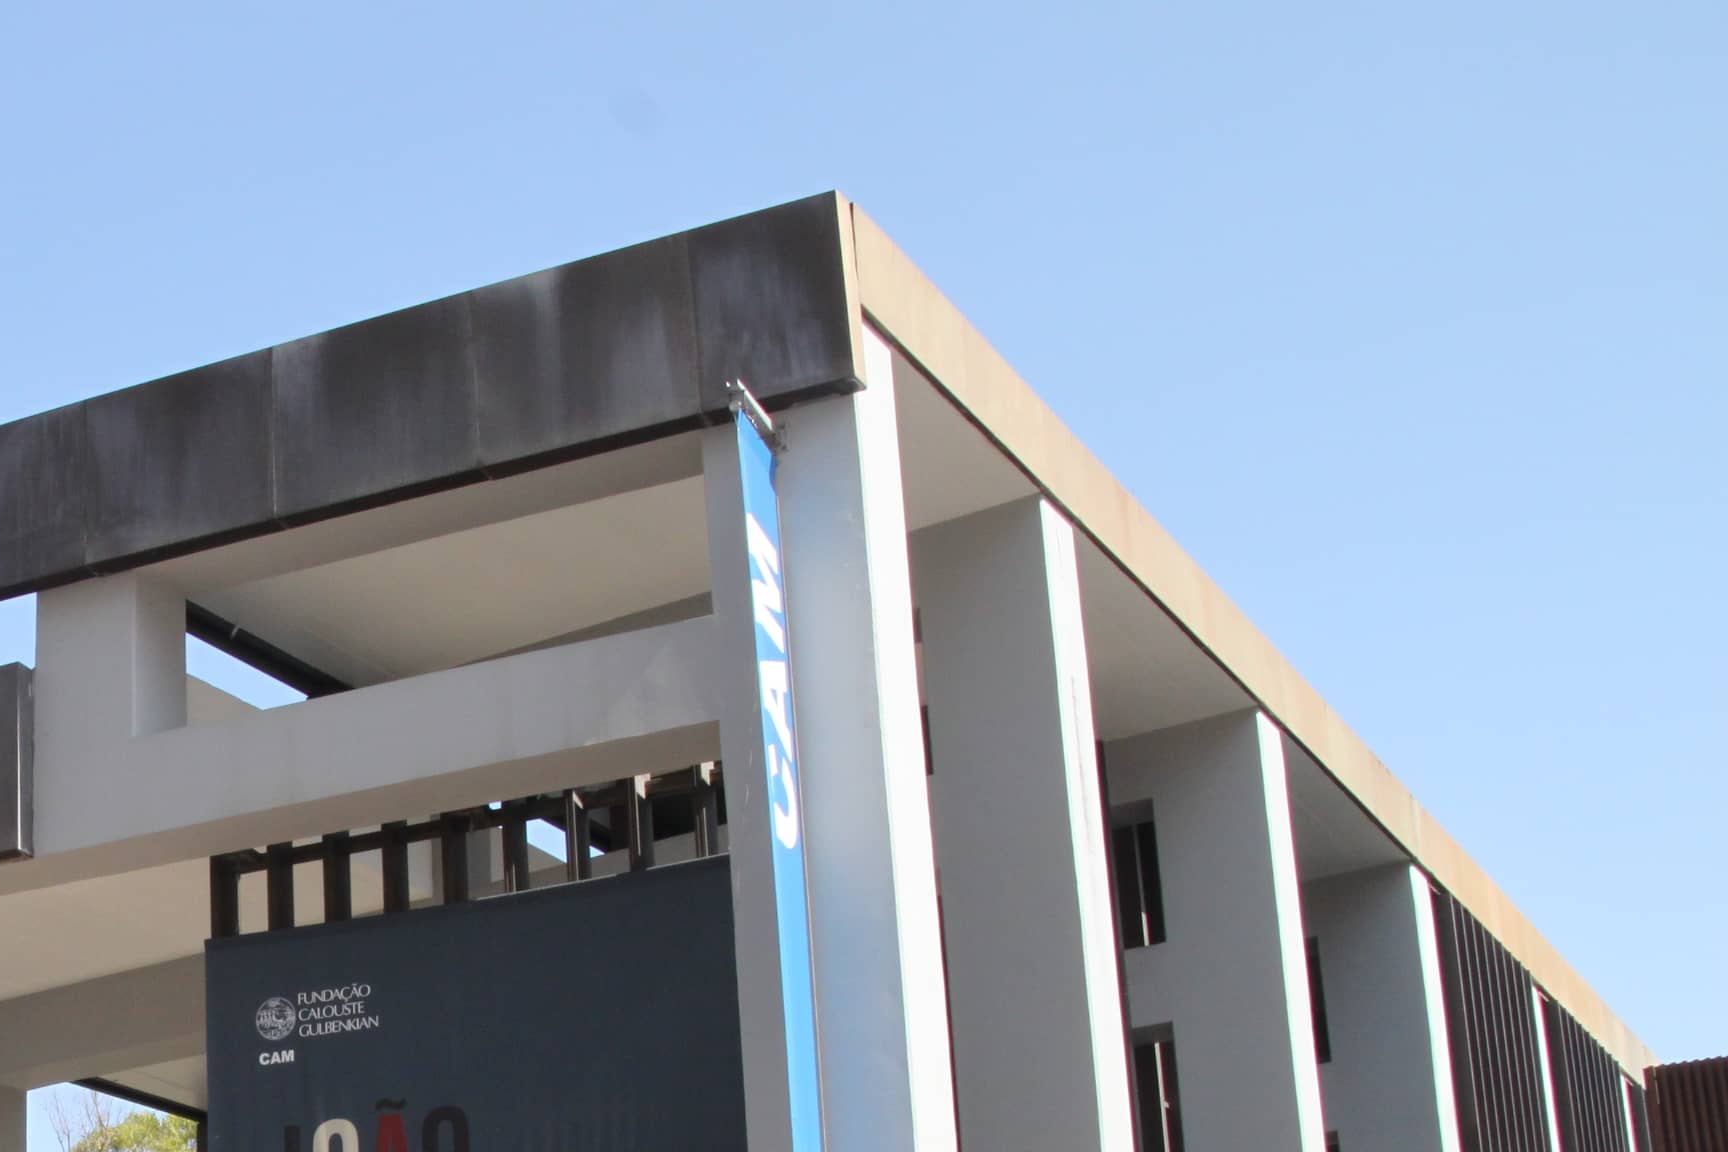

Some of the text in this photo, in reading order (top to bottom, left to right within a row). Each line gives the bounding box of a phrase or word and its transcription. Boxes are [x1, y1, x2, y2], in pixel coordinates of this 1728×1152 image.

[745, 511, 798, 850] CAM
[297, 982, 372, 1005] FUNDAÇÃO
[298, 1001, 366, 1021] CALOUSTE
[298, 1015, 380, 1037] GULBENKIAN
[259, 1049, 295, 1066] CAM
